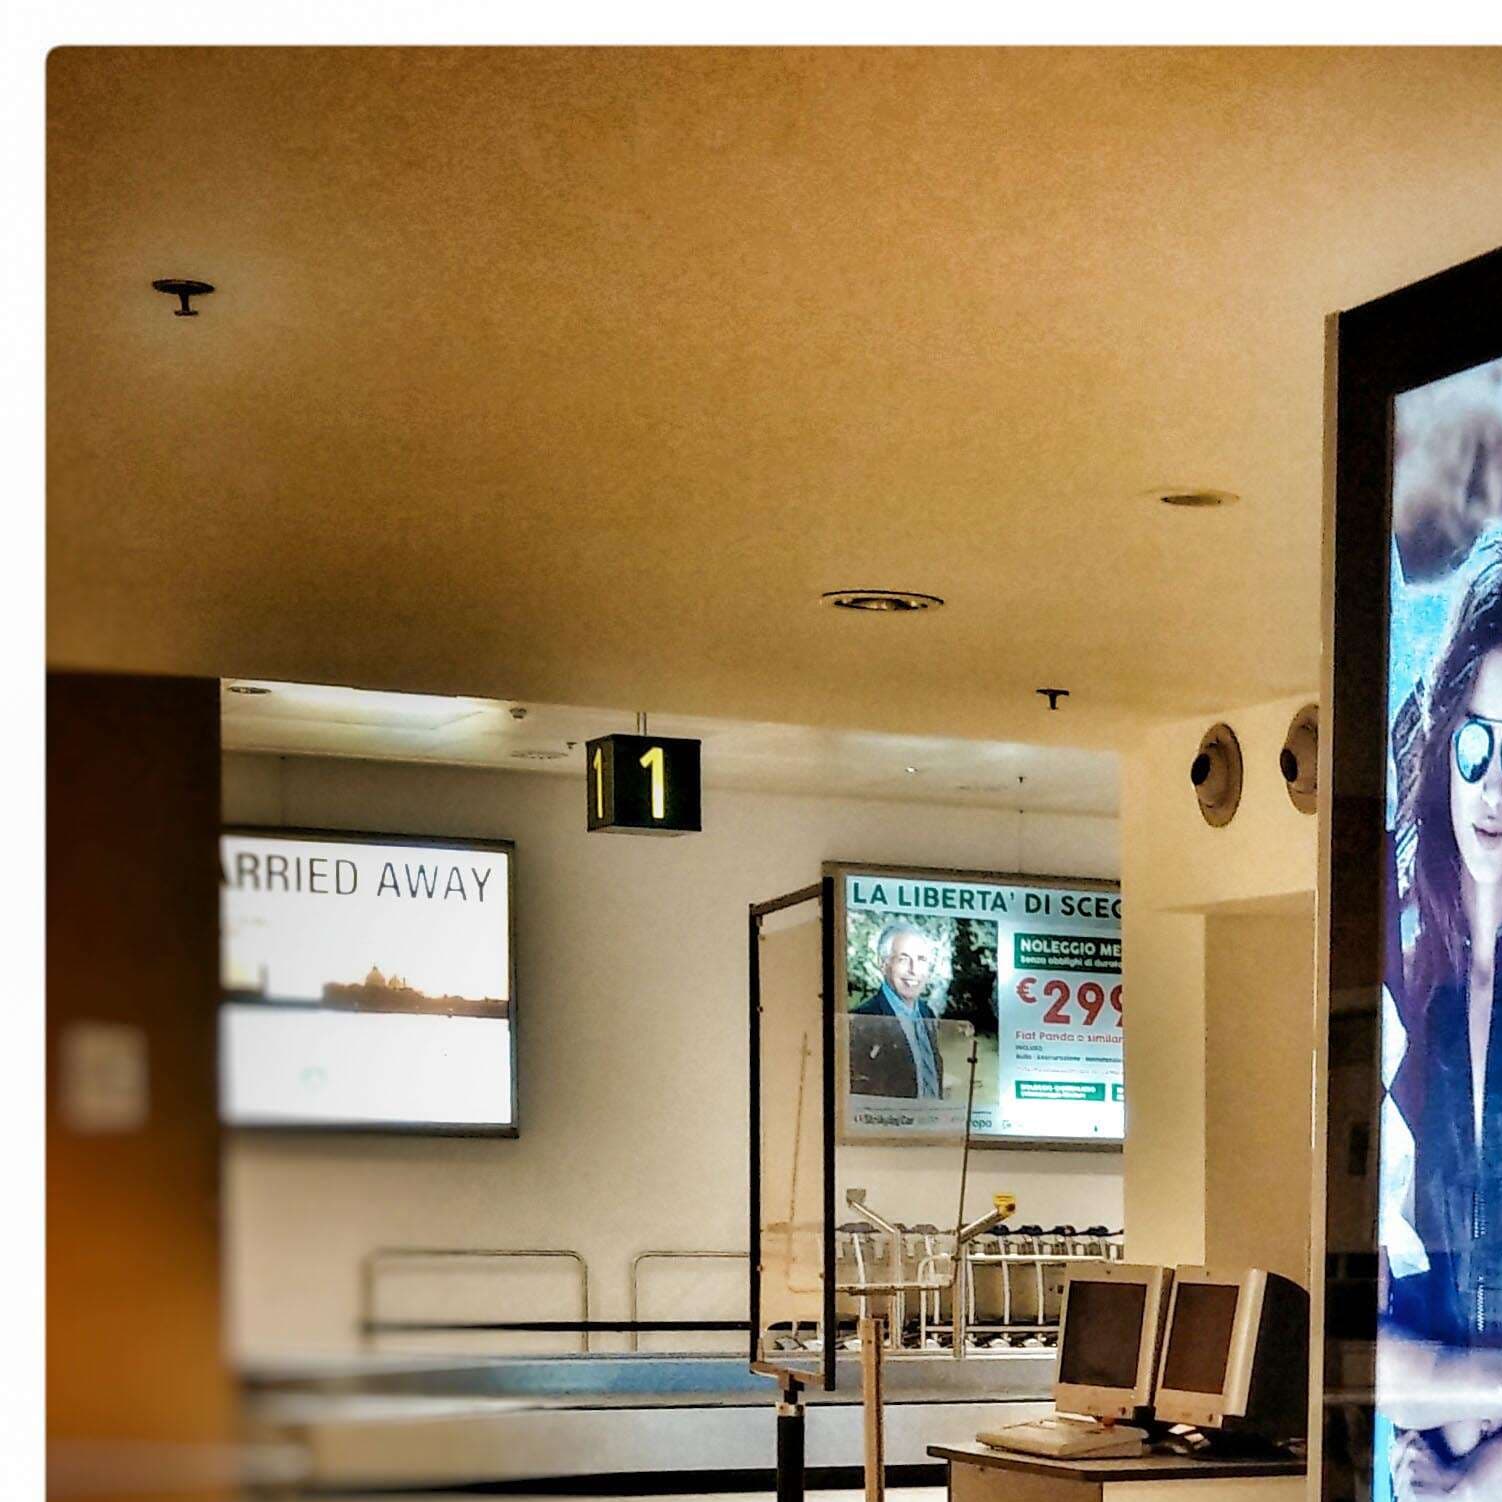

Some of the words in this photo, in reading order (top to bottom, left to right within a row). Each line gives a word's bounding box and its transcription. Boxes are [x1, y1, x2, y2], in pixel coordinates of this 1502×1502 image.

[593, 747, 603, 818] 1
[639, 747, 664, 819] 1
[377, 862, 491, 902] AWAY
[853, 882, 888, 904] LA
[898, 886, 1014, 912] LIBERTA'
[1025, 893, 1050, 915] DI
[1021, 939, 1096, 955] NOLEGGIO
[1016, 1031, 1036, 1040] Fiat
[1040, 1032, 1075, 1042] Panda
